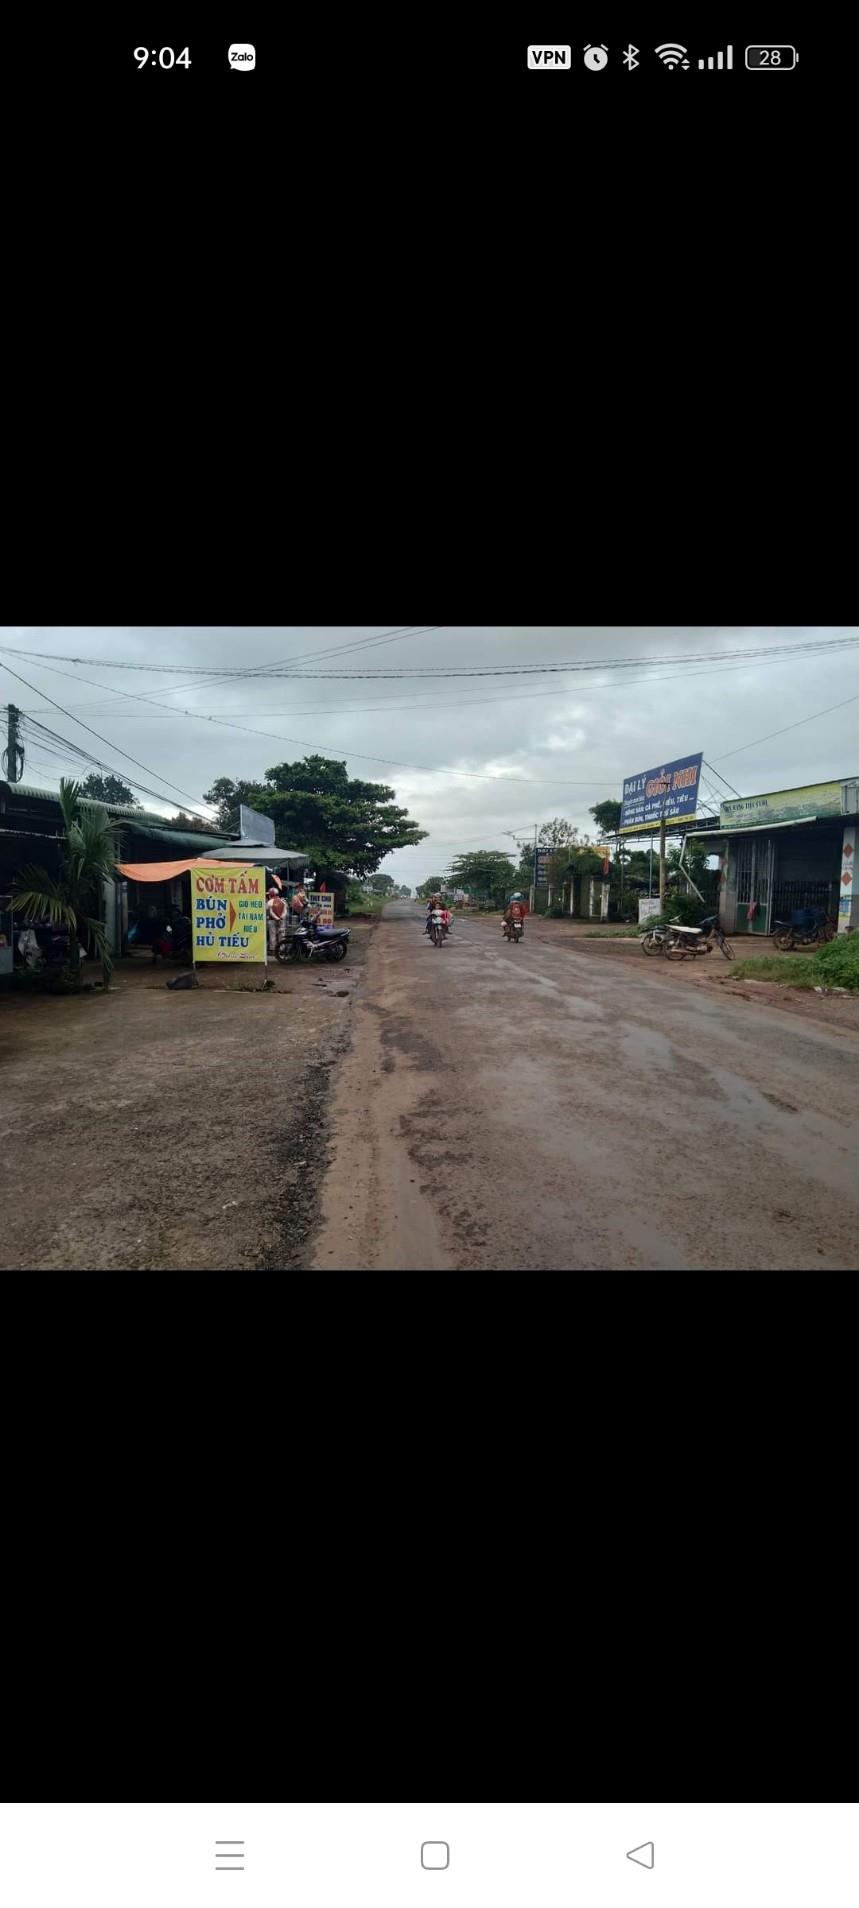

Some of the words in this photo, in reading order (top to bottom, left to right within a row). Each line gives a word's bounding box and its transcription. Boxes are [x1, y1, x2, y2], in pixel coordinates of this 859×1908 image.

[196, 874, 225, 894] CƠM
[227, 870, 259, 894] TẤM
[196, 896, 227, 911] BÚN
[196, 912, 226, 929] PHỞ
[196, 931, 215, 946] HỦ
[218, 931, 249, 947] TIẾU
